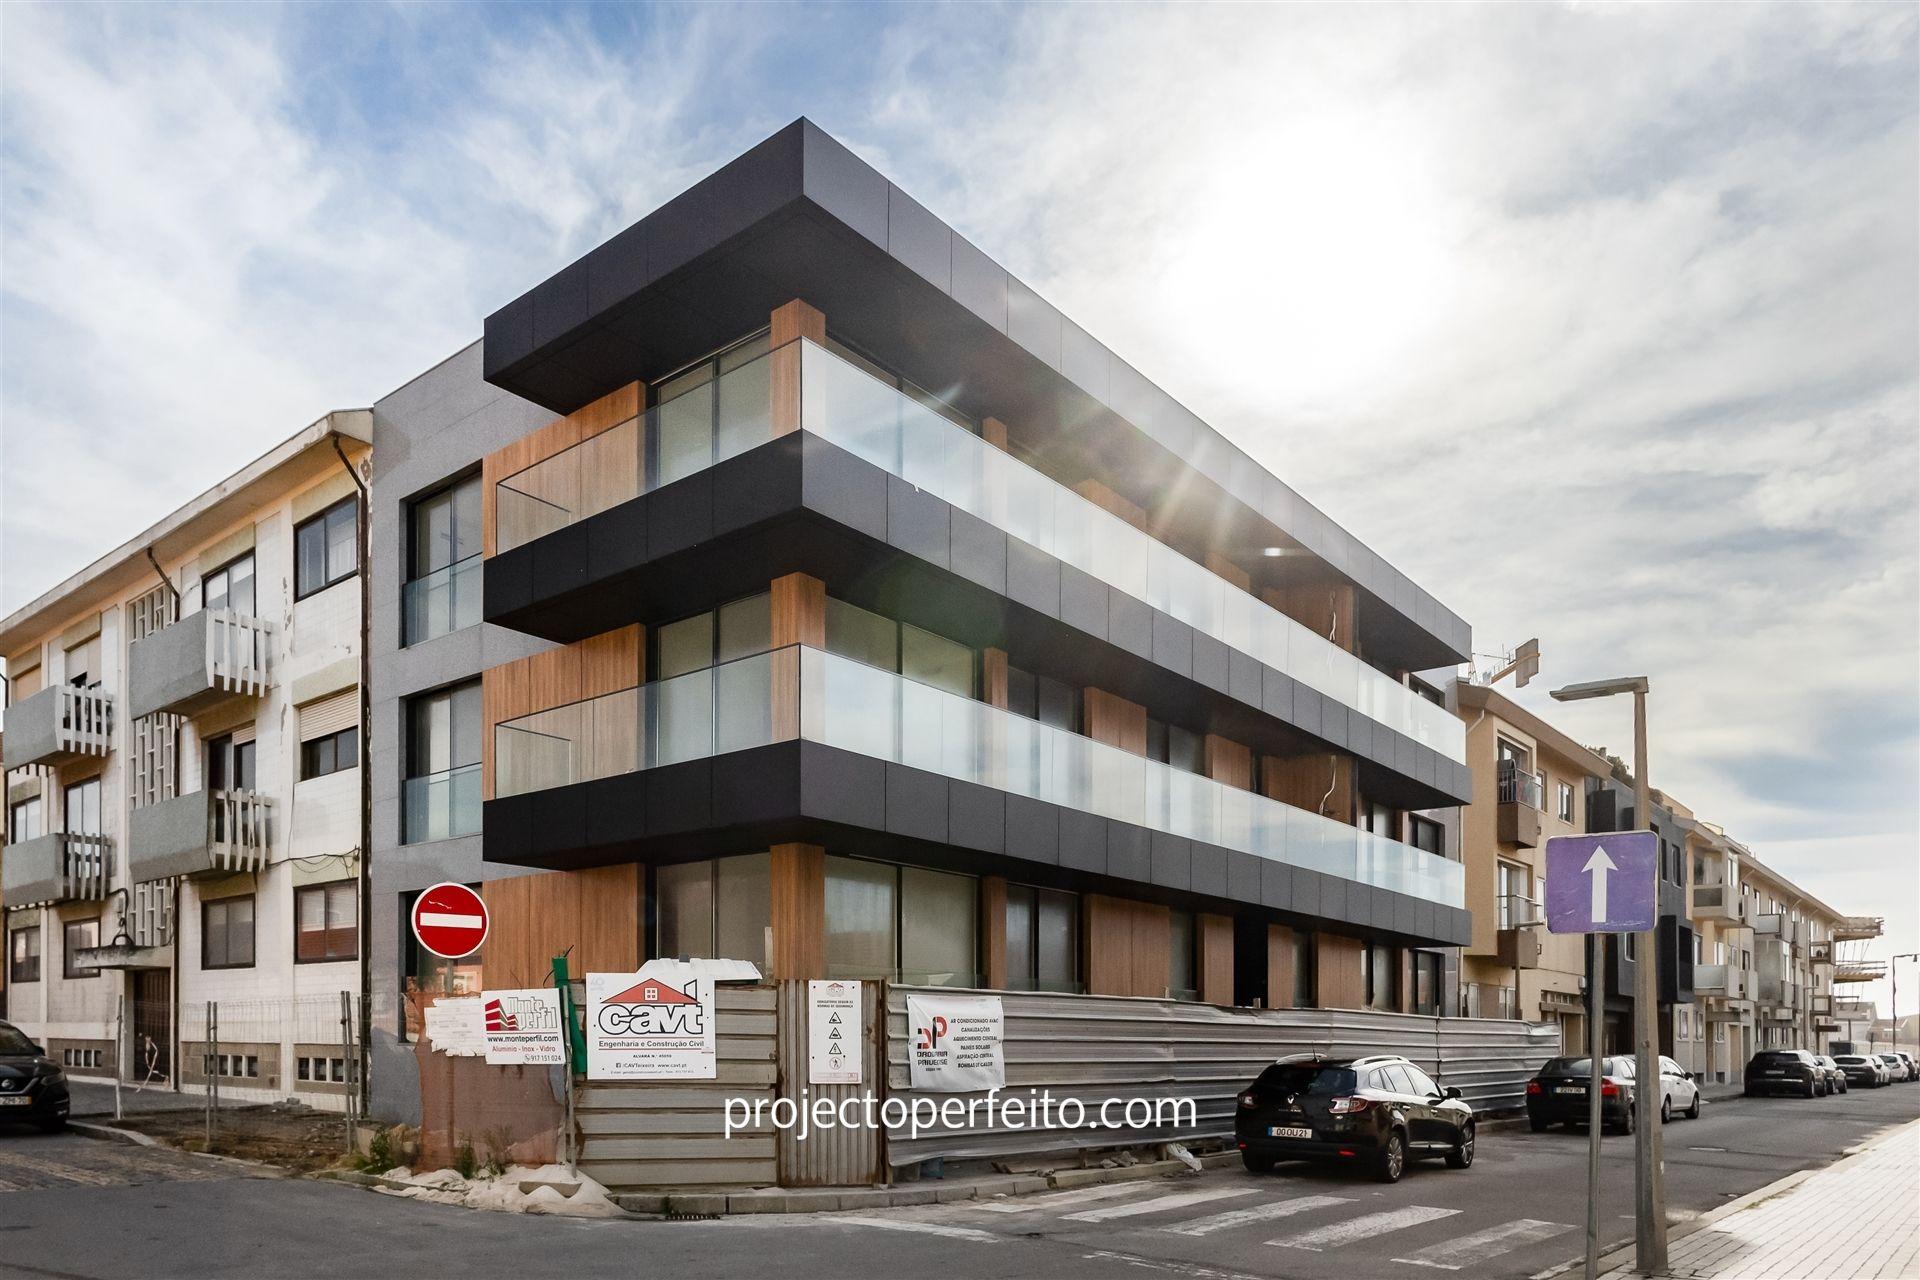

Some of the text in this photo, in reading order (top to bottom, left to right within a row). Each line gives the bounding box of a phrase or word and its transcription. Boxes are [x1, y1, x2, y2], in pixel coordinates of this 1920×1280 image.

[519, 1006, 558, 1031] perfil
[487, 1034, 559, 1043] www.monteperfil.com
[598, 1040, 639, 1049] Engenharia
[646, 1040, 687, 1049] Construção
[688, 1040, 704, 1048] Civil
